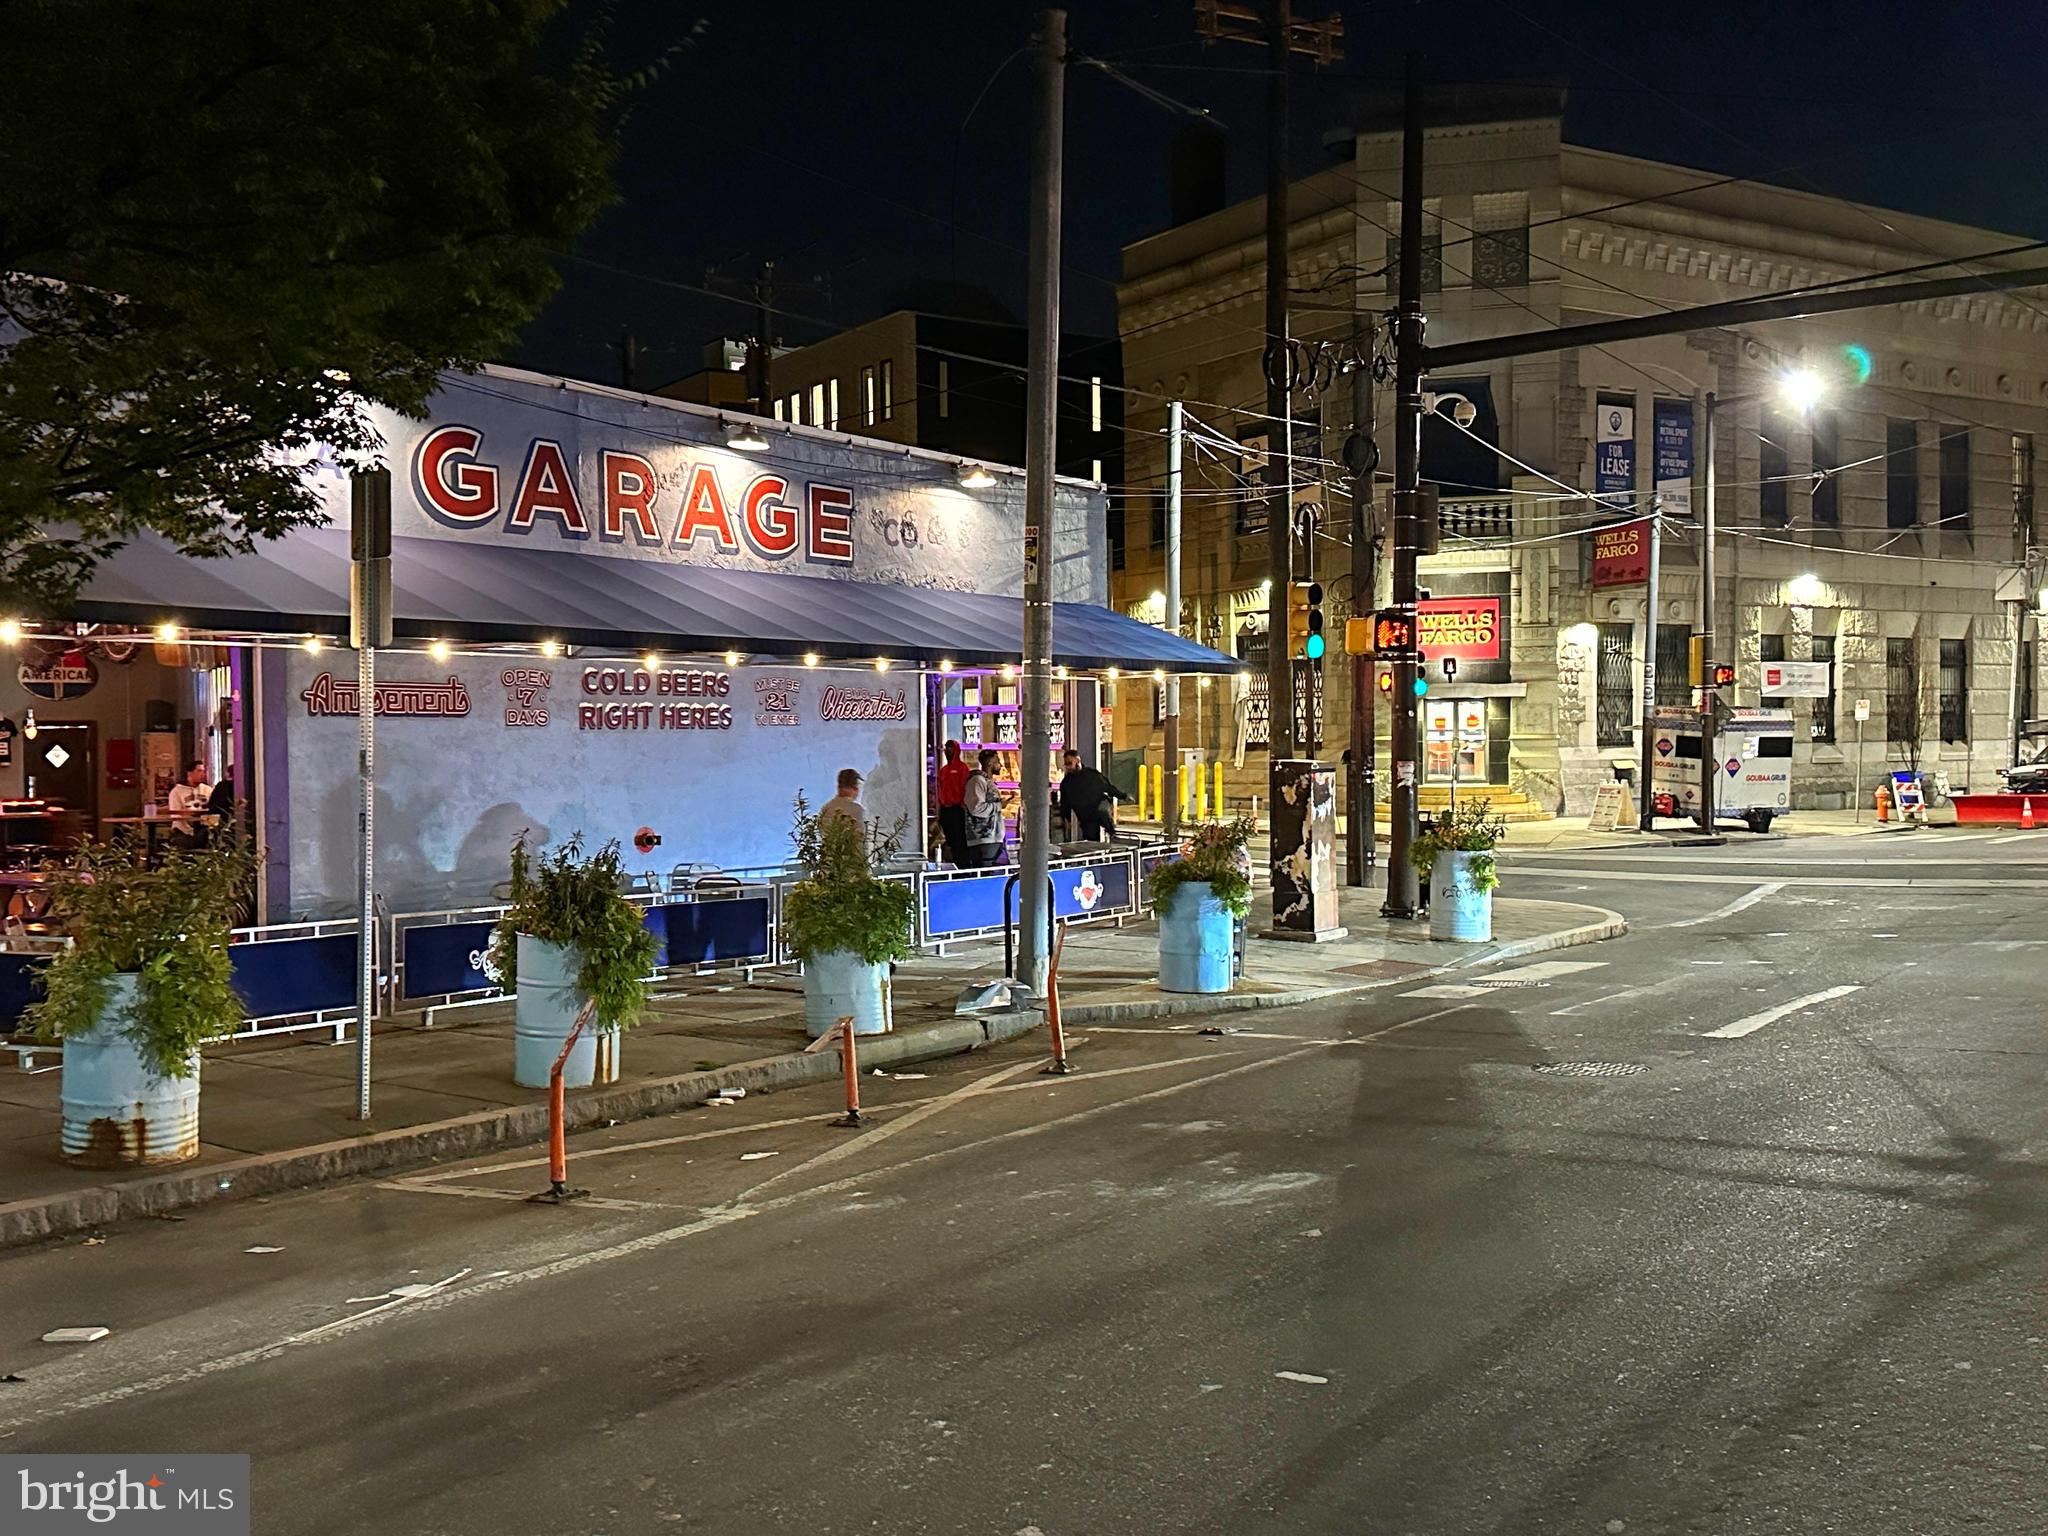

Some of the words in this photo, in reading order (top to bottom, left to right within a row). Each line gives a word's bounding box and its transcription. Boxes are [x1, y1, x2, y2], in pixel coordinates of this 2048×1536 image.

[1608, 444, 1623, 458] FOR
[1600, 457, 1630, 477] LEASE
[412, 423, 854, 567] GARAGE
[1594, 530, 1640, 547] WELLS
[1596, 544, 1640, 561] FARGO
[1417, 610, 1495, 629] WELLS
[1418, 627, 1495, 646] FARGO
[501, 669, 551, 688] OPEN
[582, 666, 650, 695] COLD
[655, 668, 731, 697] BEERS
[754, 677, 785, 692] MUST
[785, 678, 800, 693] BE
[516, 688, 537, 707] 7
[765, 691, 791, 712] 21
[820, 686, 907, 721] Cheesesteak
[506, 708, 549, 727] DAYS
[579, 702, 653, 730] RIGHT
[659, 703, 733, 730] HERES
[755, 713, 769, 726] TO
[769, 714, 801, 726] ENTER
[1746, 774, 1770, 782] GOUBAA
[1771, 774, 1786, 782] GRUB
